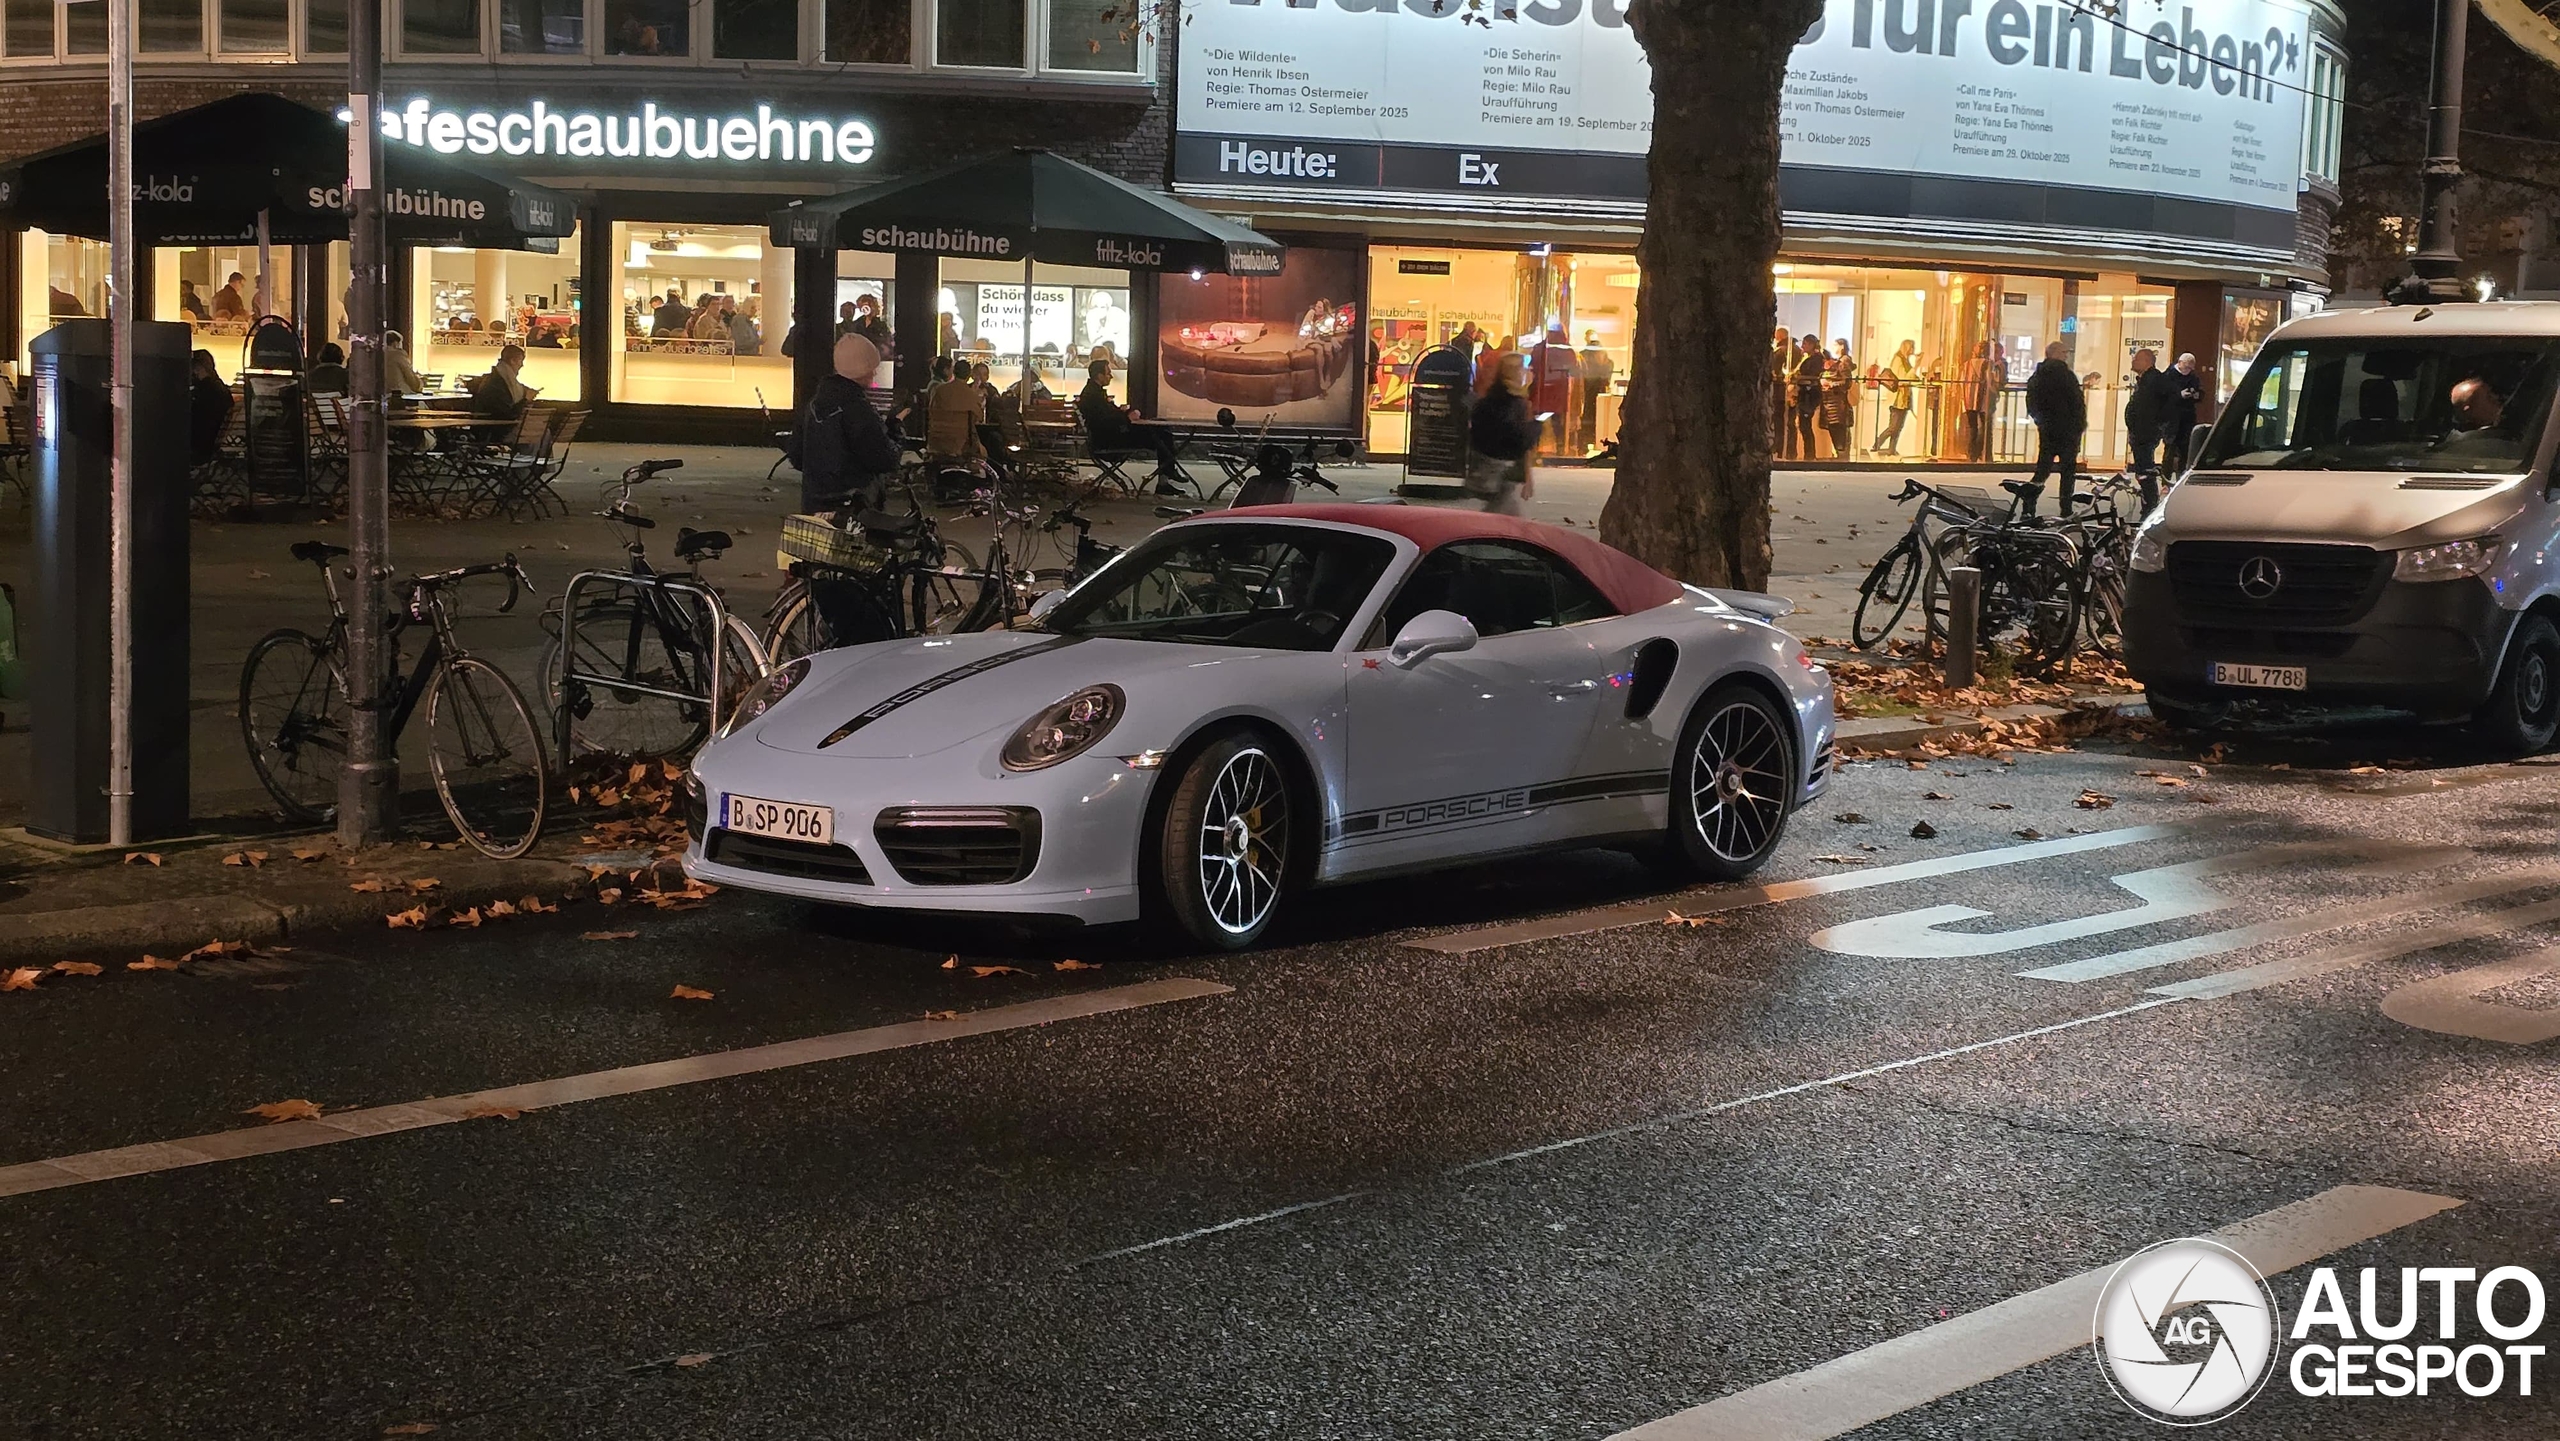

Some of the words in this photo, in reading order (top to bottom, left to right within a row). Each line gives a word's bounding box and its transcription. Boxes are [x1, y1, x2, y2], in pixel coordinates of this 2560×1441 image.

[1986, 0, 2096, 73] ein
[1207, 67, 1228, 77] von
[1232, 66, 1273, 79] Henrik
[1276, 69, 1310, 81] Ibsen
[1483, 66, 1503, 76] von
[1507, 65, 1531, 77] Milo
[1535, 67, 1557, 78] Rau
[1206, 81, 1245, 95] Regie:
[1249, 83, 1297, 97] Thomas
[1301, 86, 1369, 100] Ostermeier
[1483, 80, 1519, 94] Regie:
[1522, 82, 1546, 94] Milo
[1549, 84, 1571, 95] Rau
[1785, 84, 1834, 99] Maximilian
[1836, 88, 1868, 101] Jakobs
[1978, 88, 1991, 97] me
[1206, 98, 1261, 111] Premiere
[1265, 103, 1284, 112] am
[1288, 102, 1305, 114] 12.
[1309, 102, 1376, 117] September
[1380, 106, 1409, 119] 2025
[1482, 96, 1558, 112] Uraufführung
[1795, 103, 1811, 112] von
[1814, 102, 1851, 115] Thomas
[1854, 105, 1905, 119] Ostermeier
[1955, 101, 1970, 110] von
[1973, 100, 1992, 112] Yana
[1994, 103, 2009, 114] Eva
[1481, 112, 1533, 125] Premiere
[1536, 117, 1554, 126] am
[1558, 117, 1574, 128] 19.
[1577, 117, 1637, 131] September
[1640, 121, 1653, 131] 20
[1955, 114, 1981, 127] Regie:
[1982, 117, 2002, 128] Yana
[2003, 118, 2018, 129] Eva
[337, 98, 875, 164] afeschaubuehne
[1807, 132, 1846, 145] Oktober
[1848, 135, 1871, 147] 2025
[1953, 143, 1989, 156] Premiere
[1991, 149, 2004, 158] am
[2020, 149, 2052, 161] Oktober
[1219, 140, 1336, 178] Heute:
[1459, 153, 1500, 185] Ex
[106, 174, 193, 202] z-kola
[309, 187, 486, 220] scbühne
[862, 225, 1011, 255] schaubühne
[1096, 239, 1162, 266] fritz-kola
[1033, 290, 1065, 302] dass
[981, 303, 999, 314] du
[1366, 306, 1428, 319] haubühne
[981, 318, 998, 328] da
[2124, 337, 2165, 349] Eingang
[2217, 666, 2227, 682] B
[2237, 667, 2258, 684] UL
[1384, 791, 1525, 828] PORSCHE
[734, 799, 744, 826] B
[755, 804, 779, 832] SP
[784, 807, 822, 838] 906
